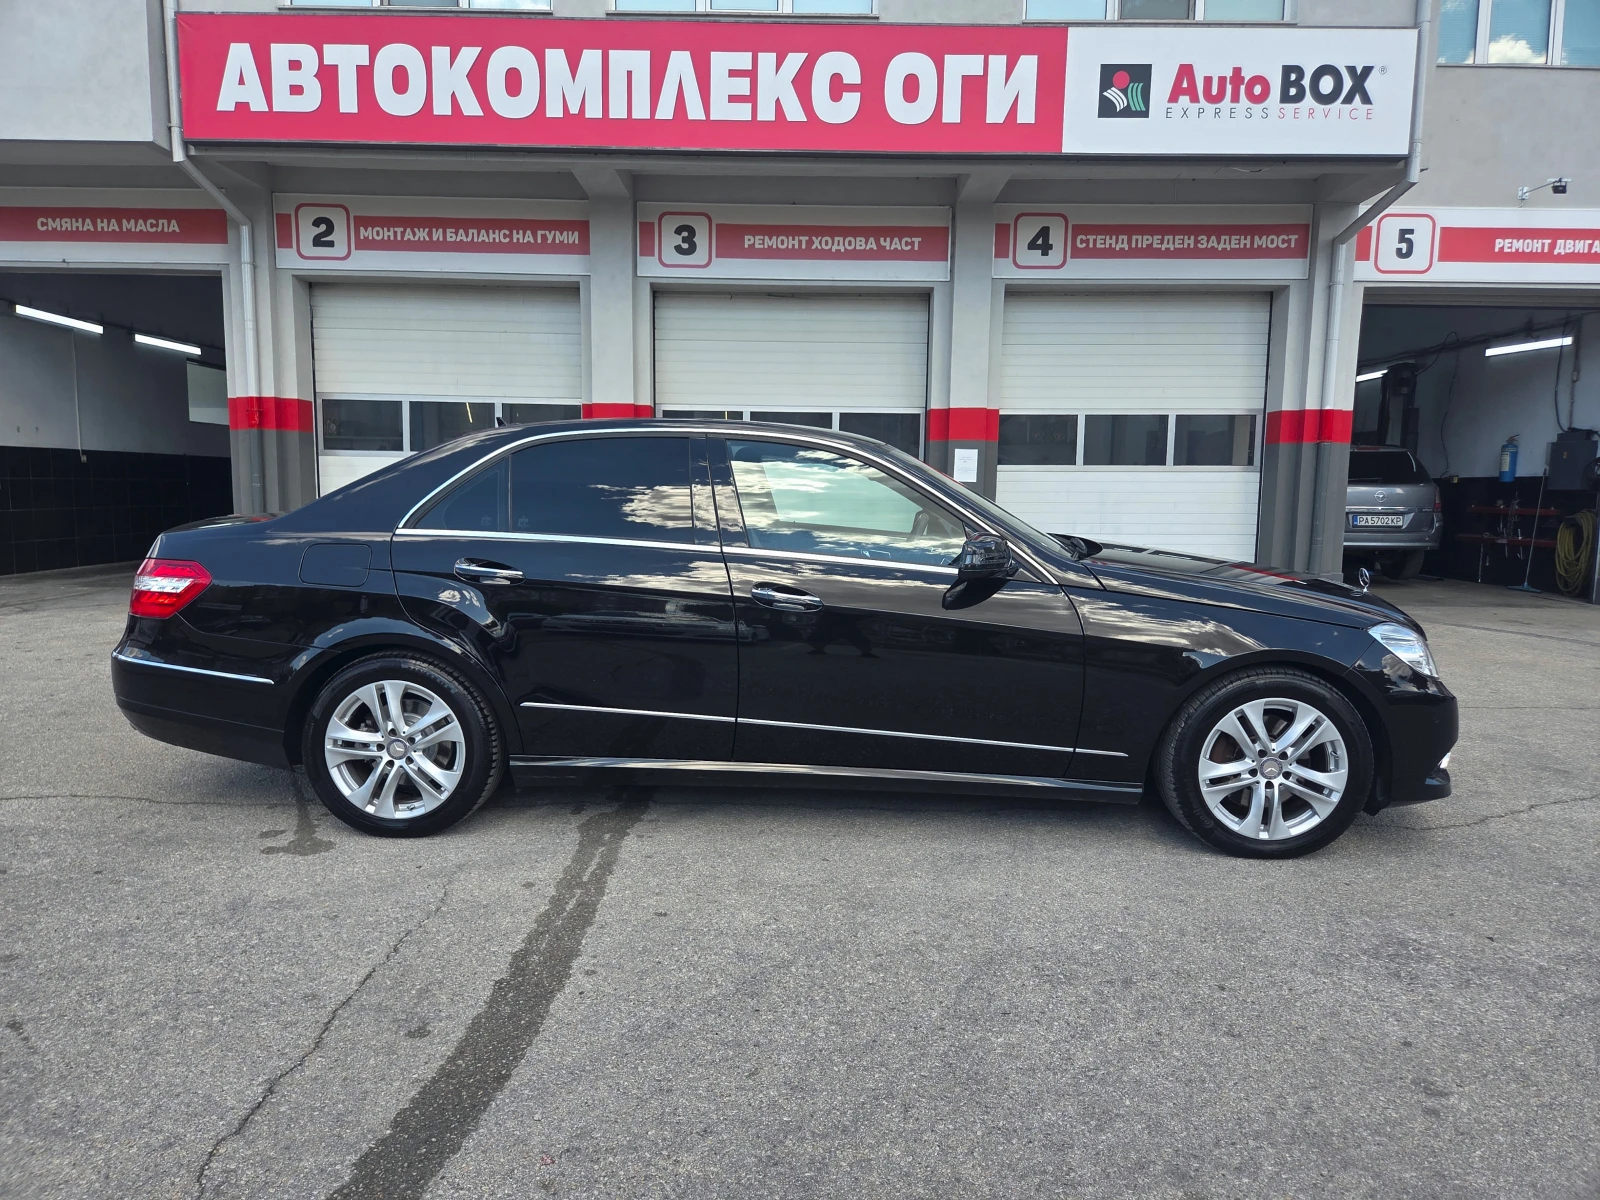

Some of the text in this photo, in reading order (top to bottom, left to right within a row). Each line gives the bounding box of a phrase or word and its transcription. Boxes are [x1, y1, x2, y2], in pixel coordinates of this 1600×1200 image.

[216, 42, 1039, 125] АВТОКОМПЛЕКС ОГИ
[36, 217, 180, 233] СМЯНА НА МАСЛА
[311, 216, 335, 248] 2
[359, 226, 580, 244] МОНТАЖ И БАЛАНС НА ГУМИ
[673, 224, 698, 256] 3
[744, 235, 922, 252] РЕМОНТ ХОДОВА ЧАСТ
[1026, 225, 1054, 257] 4
[1076, 234, 1299, 250] СТЕНД ПРЕДЕН ЗАДЕН МОСТ
[1395, 228, 1415, 259] 5
[1494, 238, 1552, 253] РЕМОНТ
